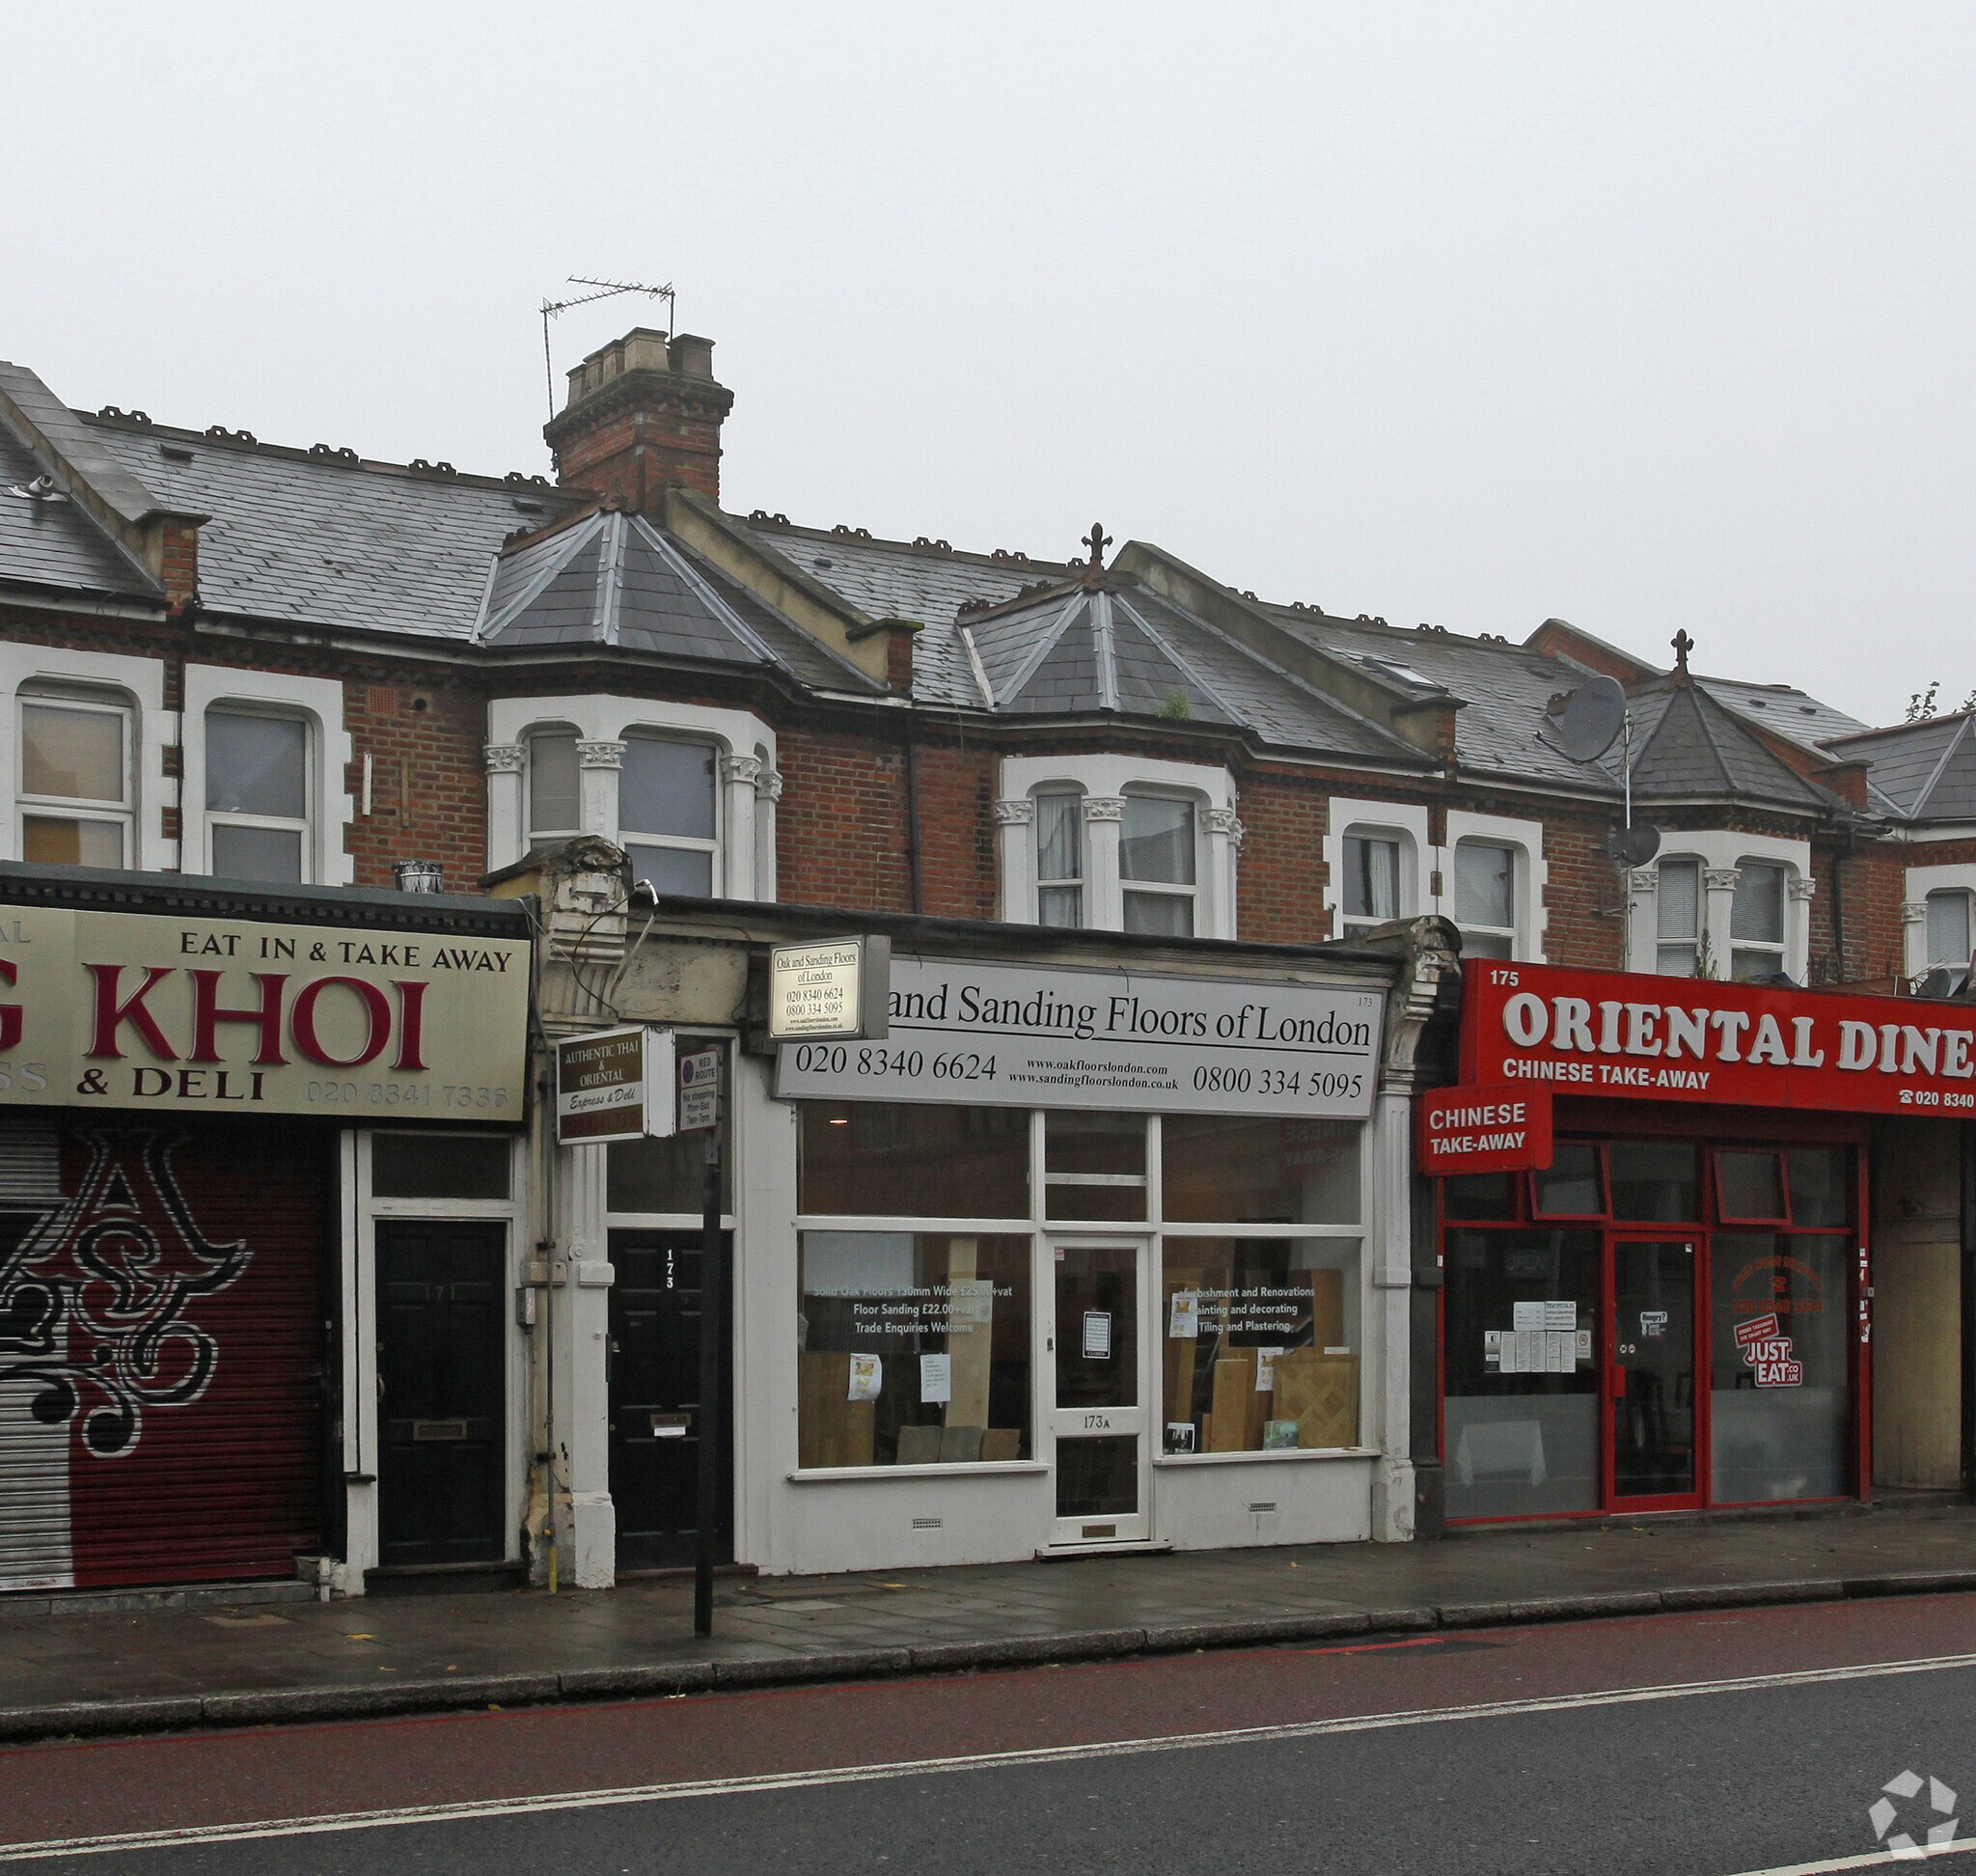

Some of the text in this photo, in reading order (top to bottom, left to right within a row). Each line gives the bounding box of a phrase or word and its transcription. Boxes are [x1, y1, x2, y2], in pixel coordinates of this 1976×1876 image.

[179, 931, 512, 973] EAT IN & TAKE AWAY
[777, 952, 857, 969] Oak and Sanding Floors
[798, 970, 833, 982] of London
[1490, 970, 1520, 987] 175
[786, 987, 843, 1003] 020 8340 6624
[1358, 997, 1373, 1008] 173
[82, 962, 430, 1072] KHOI
[786, 1002, 843, 1017] 0800 334 5095
[888, 984, 1371, 1047] and Sanding Floors of London
[1501, 991, 1976, 1079] ORIENTAL DINE
[565, 1040, 639, 1064] AUTHENTIC THAI
[599, 1060, 605, 1070] &
[699, 1057, 712, 1067] RED
[795, 1044, 997, 1082] 020 8340 6624
[1027, 1058, 1167, 1076] www.oakfloorslondon.com
[580, 1069, 624, 1087] ORIENTAL
[695, 1067, 716, 1080] ROUTE
[1008, 1071, 1179, 1092] www.sandingfloorslondon.co.uk
[1194, 1065, 1362, 1099] 0800 334 5095
[1502, 1059, 1711, 1090] CHINESE TAKE-AWAY
[76, 1068, 109, 1096] &
[132, 1067, 264, 1100] DELI
[307, 1082, 357, 1103] 020
[569, 1094, 605, 1110] Express
[615, 1088, 636, 1103] Deli
[683, 1090, 715, 1102] No stopping
[1916, 1090, 1974, 1108] 020 8340
[1430, 1104, 1526, 1131] CHINESE
[1431, 1132, 1525, 1154] TAKE-AWAY
[933, 1285, 957, 1297] Wide
[1241, 1286, 1258, 1297] and
[1260, 1286, 1315, 1297] Renovations
[854, 1304, 879, 1315] Floor
[882, 1304, 919, 1317] Sanding
[1196, 1303, 1298, 1317] ainting and decorating
[855, 1322, 974, 1336] Trade Enquiries Welcome
[1198, 1321, 1223, 1335] Tiling
[1226, 1320, 1243, 1331] and
[1747, 1341, 1789, 1362] JUST
[1758, 1364, 1788, 1382] EAT
[1084, 1416, 1110, 1428] 173A
